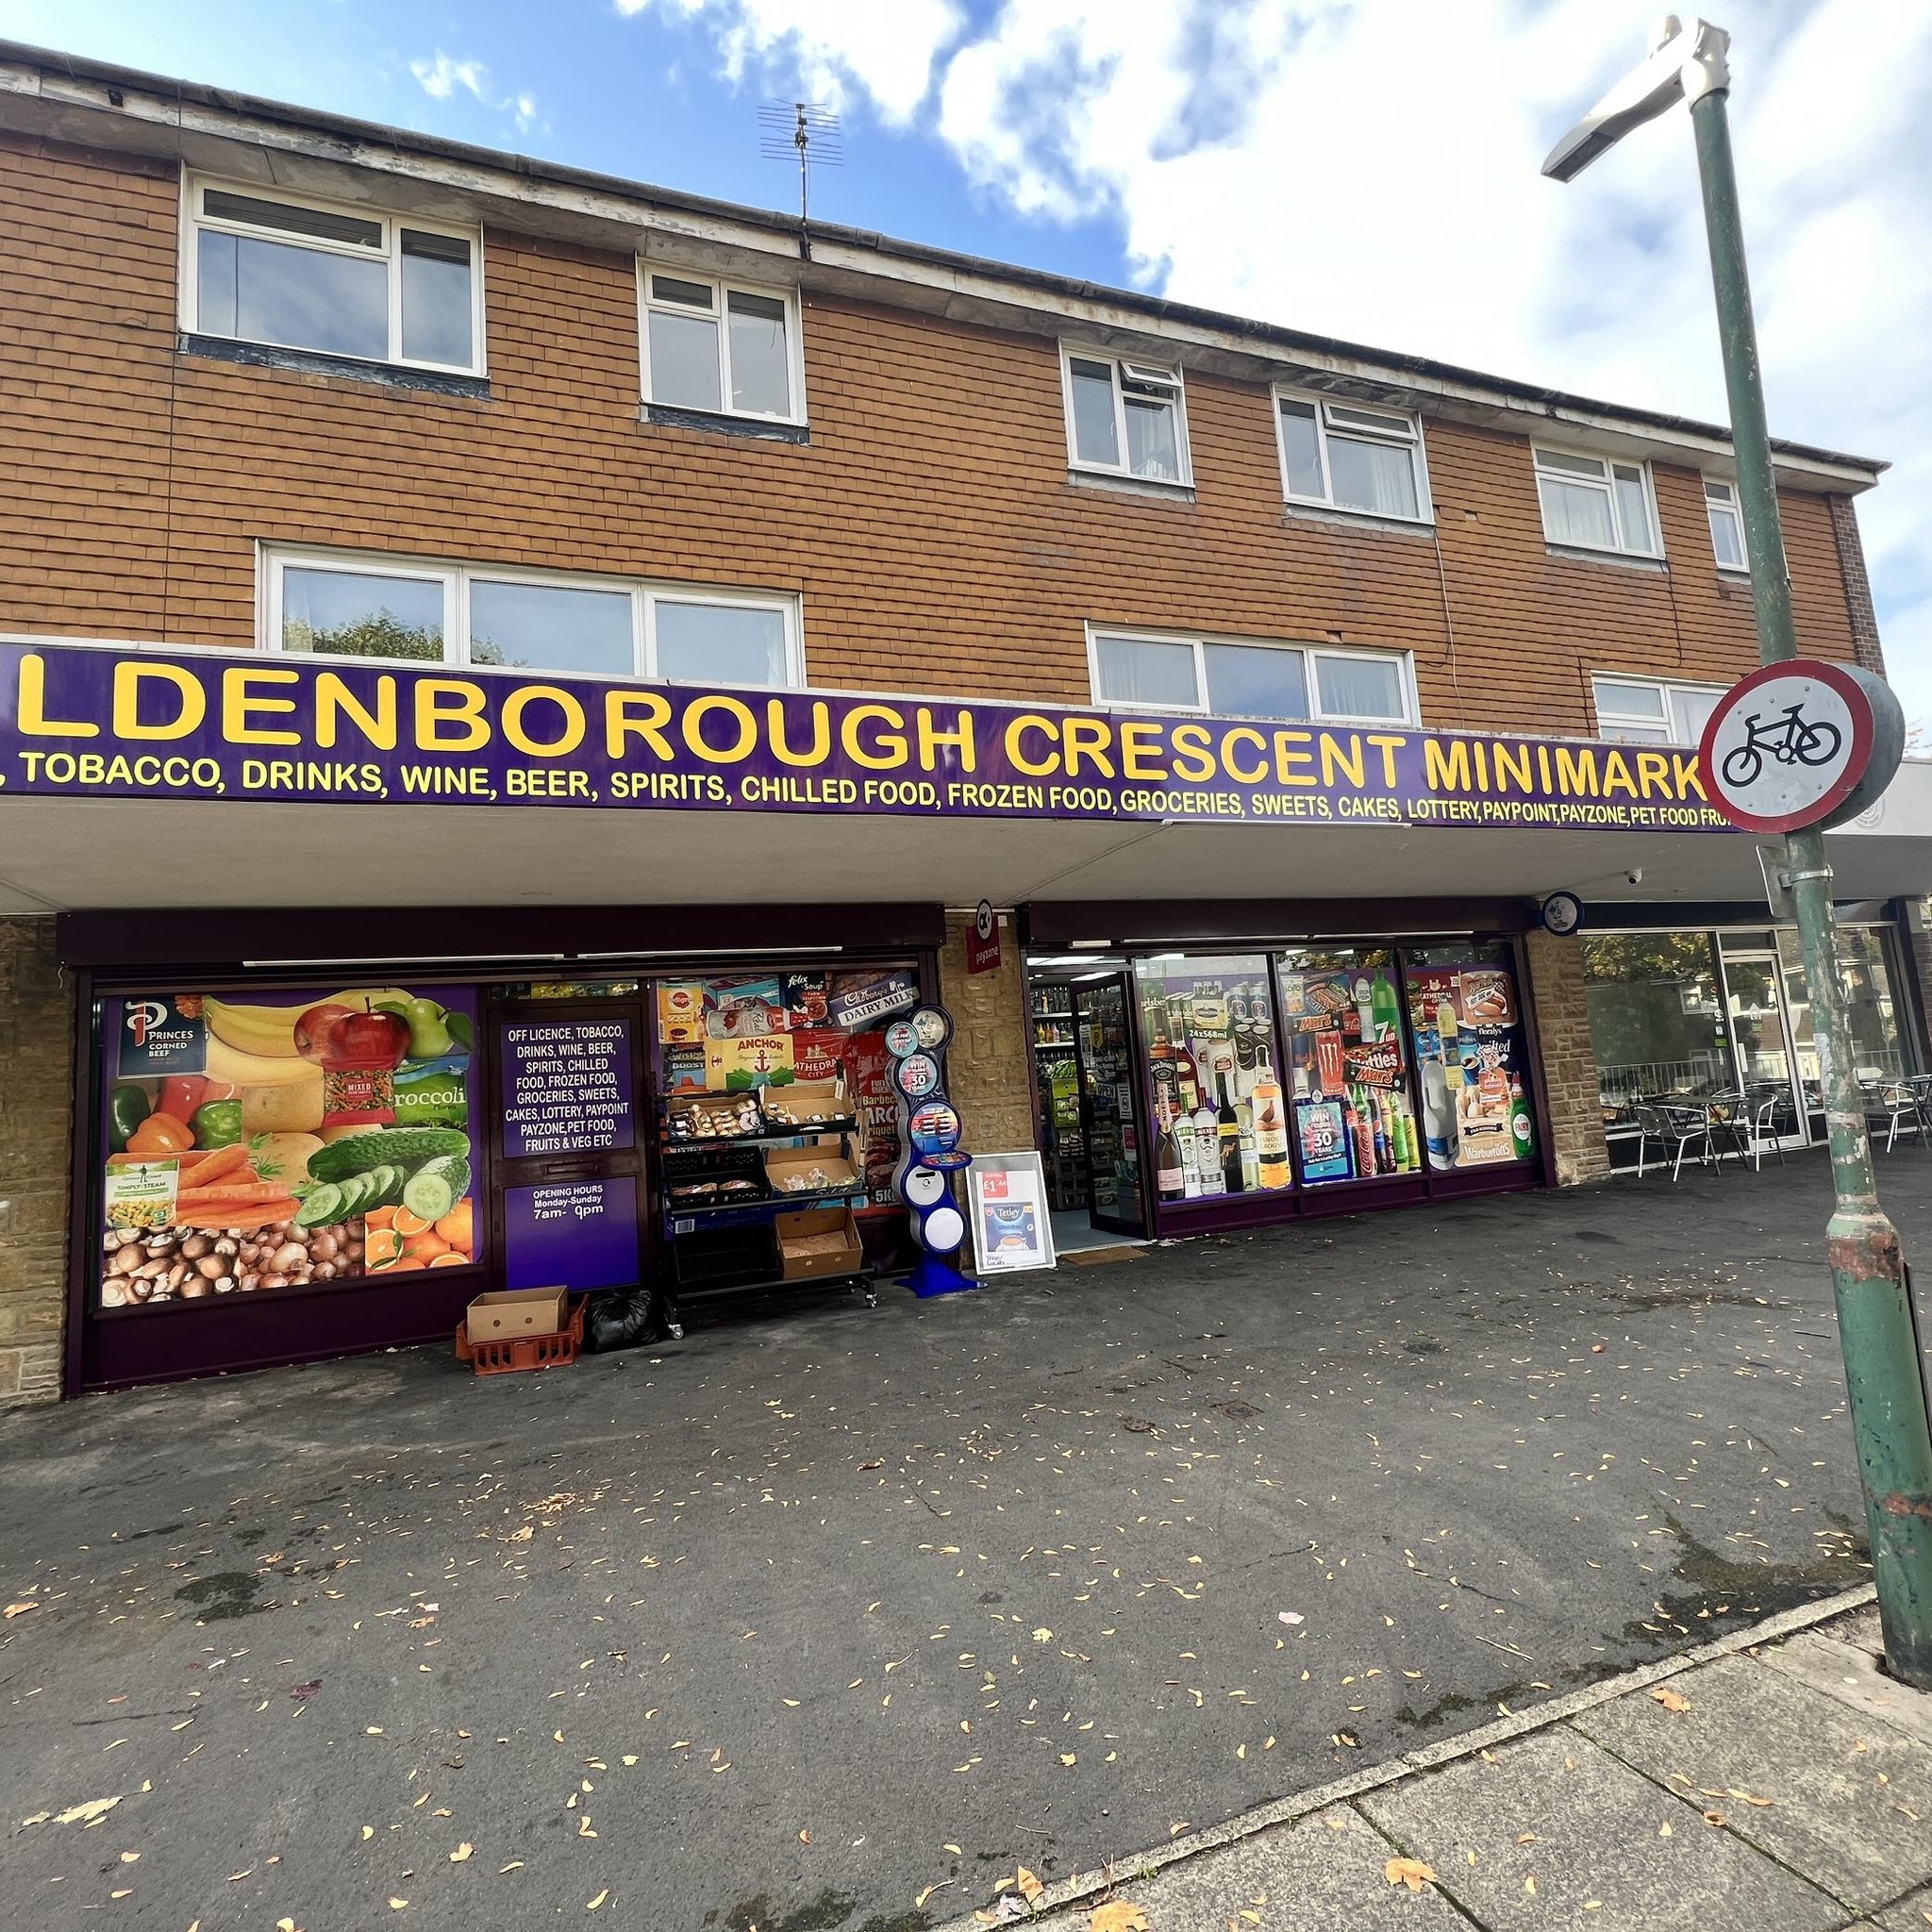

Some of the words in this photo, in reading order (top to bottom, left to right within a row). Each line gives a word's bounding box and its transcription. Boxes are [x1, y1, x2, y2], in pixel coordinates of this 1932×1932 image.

[17, 653, 976, 773] LDENBOROUGH
[1004, 714, 1407, 790] CRESCENT
[1424, 739, 1708, 802] MINIMARK
[19, 751, 225, 793] TOBACCO,
[242, 759, 389, 798] DRINKS,
[400, 765, 498, 800] WINE,
[506, 769, 598, 801] BEER,
[610, 771, 732, 805] SPIRITS,
[741, 775, 858, 805] CHILLED
[864, 780, 941, 811] FOOD,
[947, 783, 1043, 809] FROZEN
[1049, 786, 1118, 817] FOOD,
[1120, 789, 1245, 819] GROCERIES,
[1252, 794, 1332, 820] SWEETS,
[1338, 797, 1402, 823] CAKES,
[1659, 807, 1698, 826] FOOD
[844, 1001, 881, 1022] DAIRY
[885, 991, 915, 1008] MILK
[148, 1030, 193, 1041] PRINCES
[508, 1030, 527, 1041] OFF
[529, 1028, 575, 1041] LICENCE,
[576, 1025, 625, 1039] TOBACCO,
[517, 1045, 557, 1058] DRINKS,
[558, 1043, 587, 1058] WINE,
[588, 1042, 617, 1056] BEER,
[738, 1039, 784, 1051] ANCHOR
[525, 1060, 566, 1074] SPIRITS,
[568, 1058, 608, 1072] CHILLED
[793, 1057, 838, 1072] ATHEDRA
[348, 1083, 372, 1091] MIXED
[516, 1076, 547, 1090] FOOD,
[548, 1074, 588, 1088] FROZEN
[589, 1073, 618, 1086] FOOD,
[911, 1075, 926, 1086] 30
[394, 1086, 466, 1108] roccoli
[517, 1090, 576, 1105] GROCERIES,
[578, 1088, 620, 1101] SWEETS,
[863, 1095, 896, 1106] Barbec
[505, 1108, 541, 1122] CAKES,
[541, 1105, 584, 1119] LOTTERY,
[586, 1103, 629, 1117] PAYPOINT
[1310, 1112, 1329, 1123] WIN
[588, 1119, 617, 1132] FOOD,
[525, 1138, 560, 1152] FRUITS
[562, 1137, 570, 1149] &
[571, 1135, 591, 1149] VEG
[593, 1134, 612, 1146] ETC
[1314, 1131, 1332, 1148] 30
[1463, 1142, 1510, 1160] Warburtons
[533, 1188, 572, 1199] OPENING
[573, 1185, 603, 1196] HOURS
